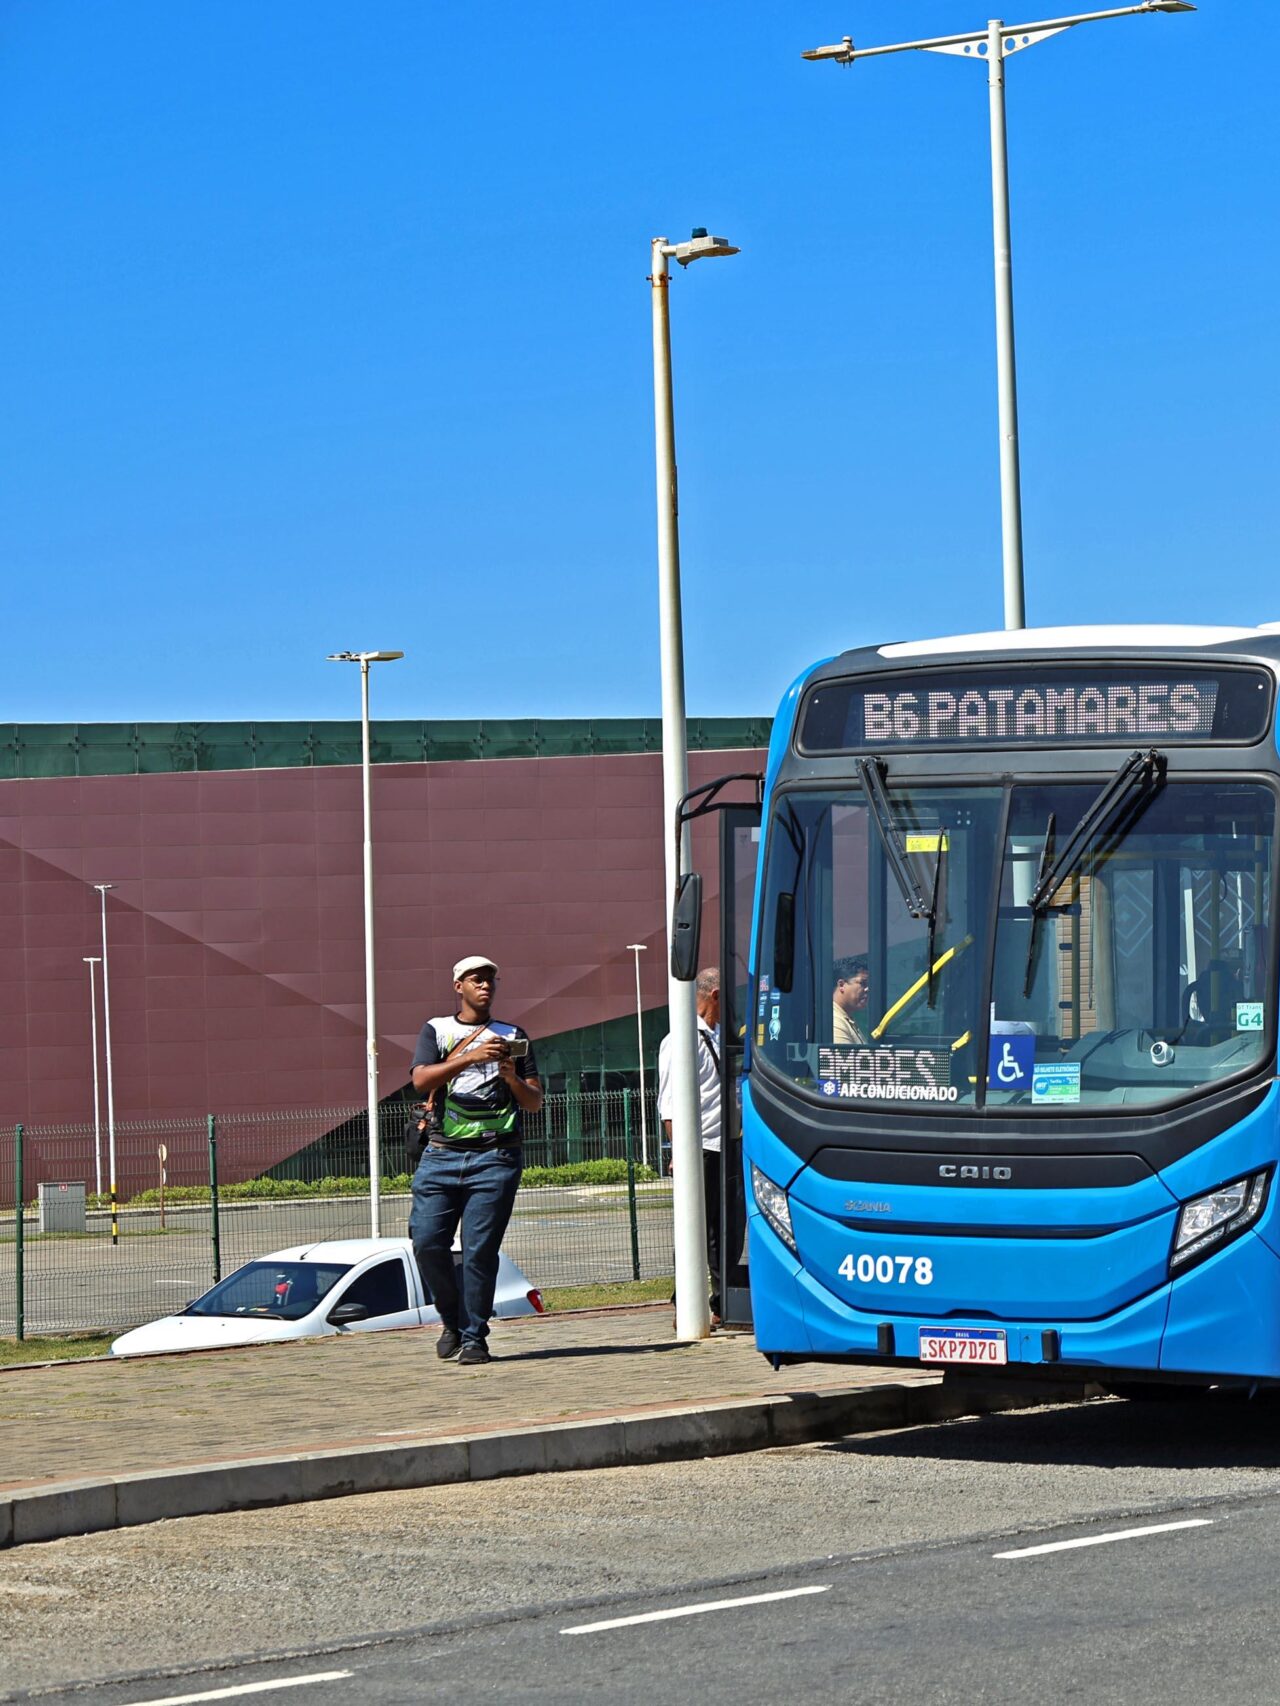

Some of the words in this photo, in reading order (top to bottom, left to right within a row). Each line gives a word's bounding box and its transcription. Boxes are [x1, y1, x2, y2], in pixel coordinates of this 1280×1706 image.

[864, 693, 919, 739] B6
[928, 684, 1200, 737] PATAMARES
[1238, 1013, 1262, 1026] G4
[840, 1083, 857, 1098] AR
[859, 1083, 958, 1101] CONDICIONADO
[939, 1165, 1012, 1180] CAIO
[844, 1200, 891, 1212] SCANIA
[838, 1254, 933, 1285] 40078
[928, 1339, 997, 1360] SKP7D70
